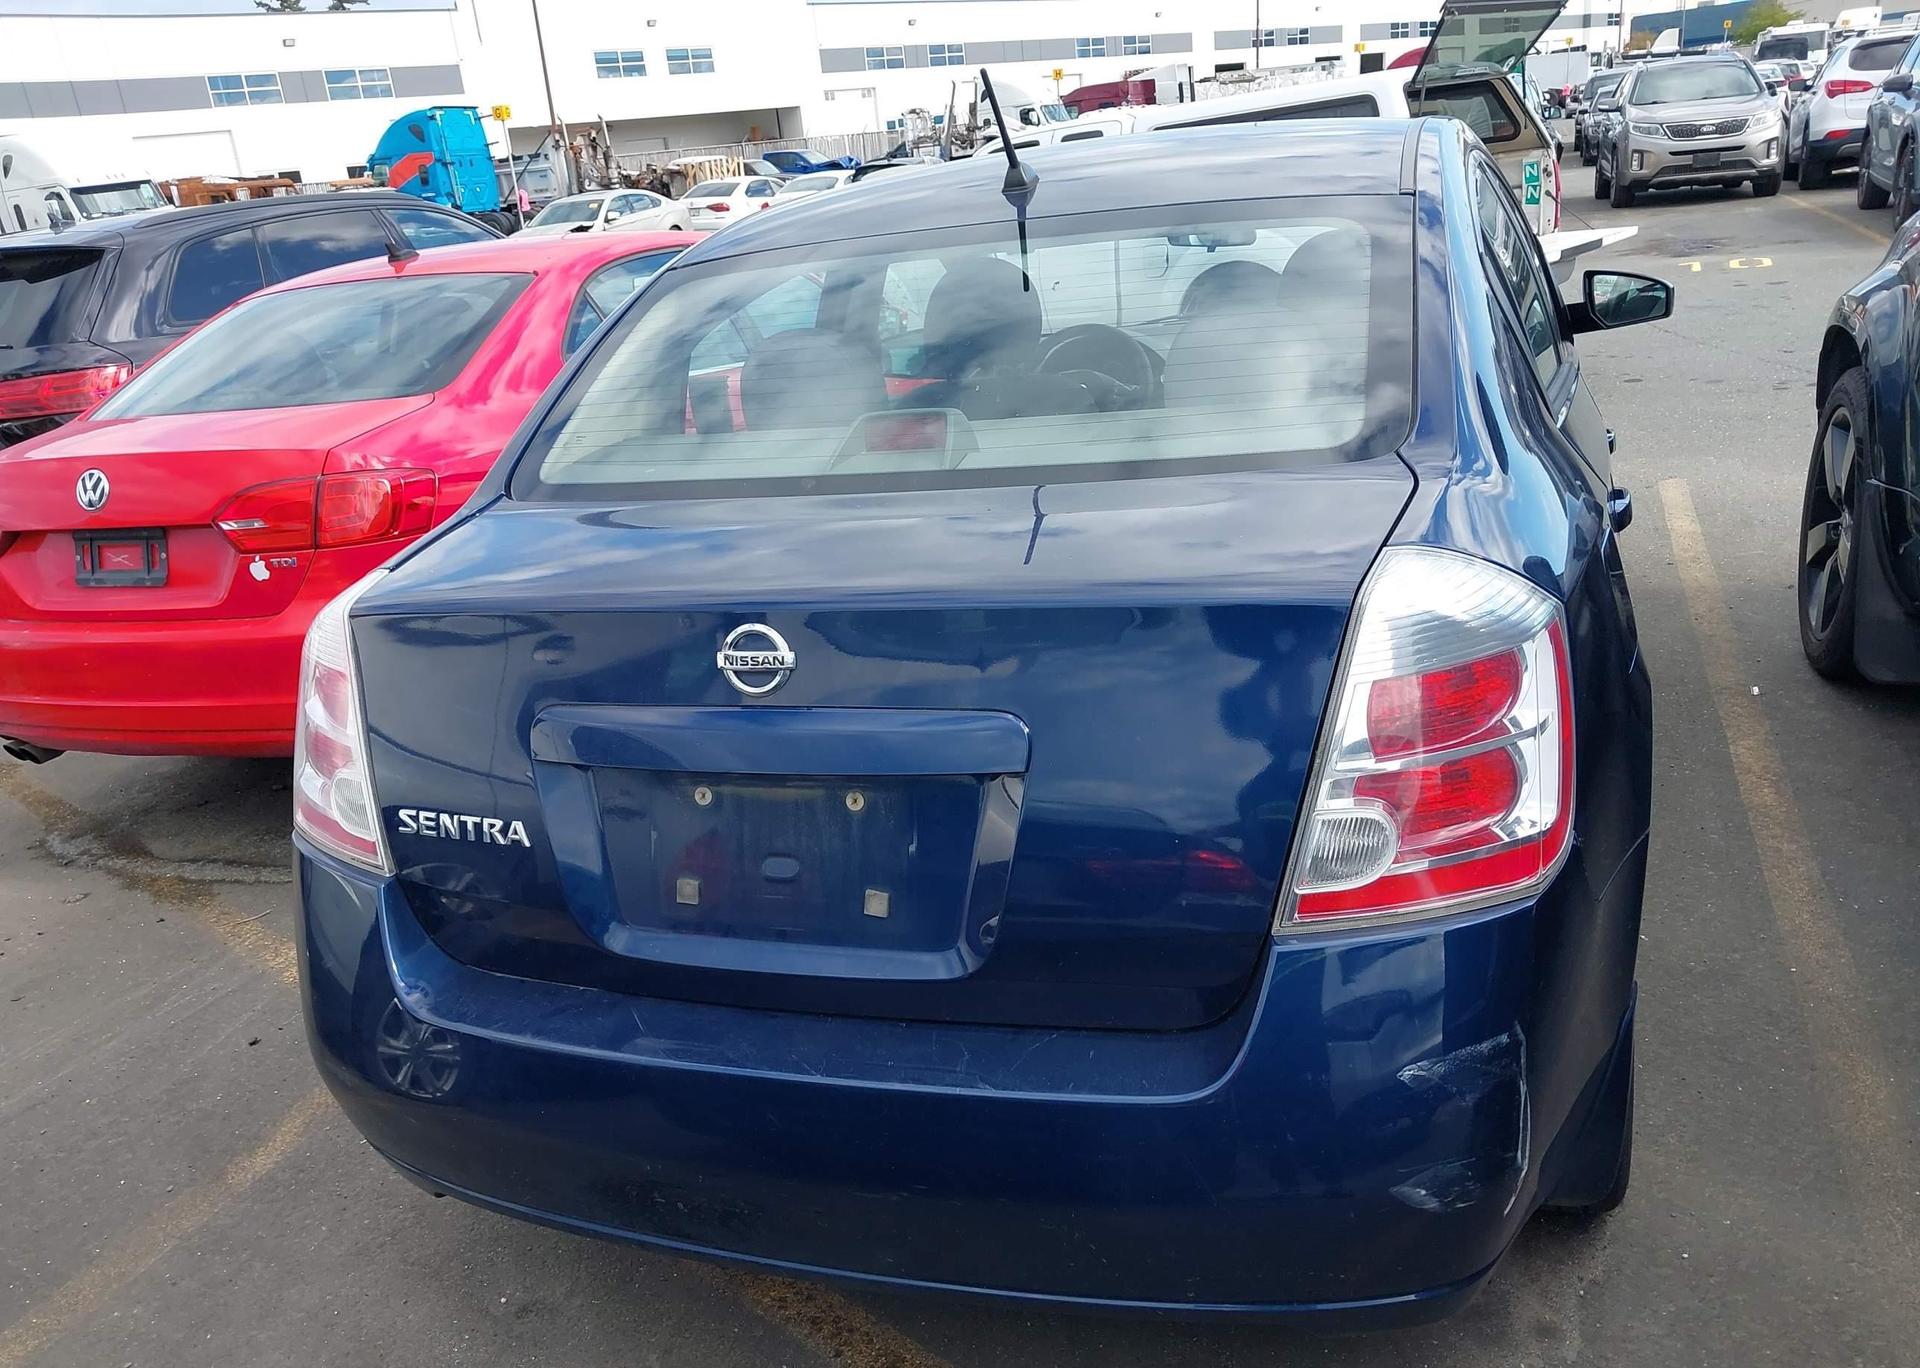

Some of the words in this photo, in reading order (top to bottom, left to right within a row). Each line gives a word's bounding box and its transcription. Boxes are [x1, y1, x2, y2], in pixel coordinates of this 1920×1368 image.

[494, 108, 502, 119] G
[1525, 163, 1538, 178] N
[1527, 186, 1540, 199] N
[77, 470, 109, 510] VW
[723, 653, 785, 667] NISSAN
[398, 808, 531, 848] SENTRA
